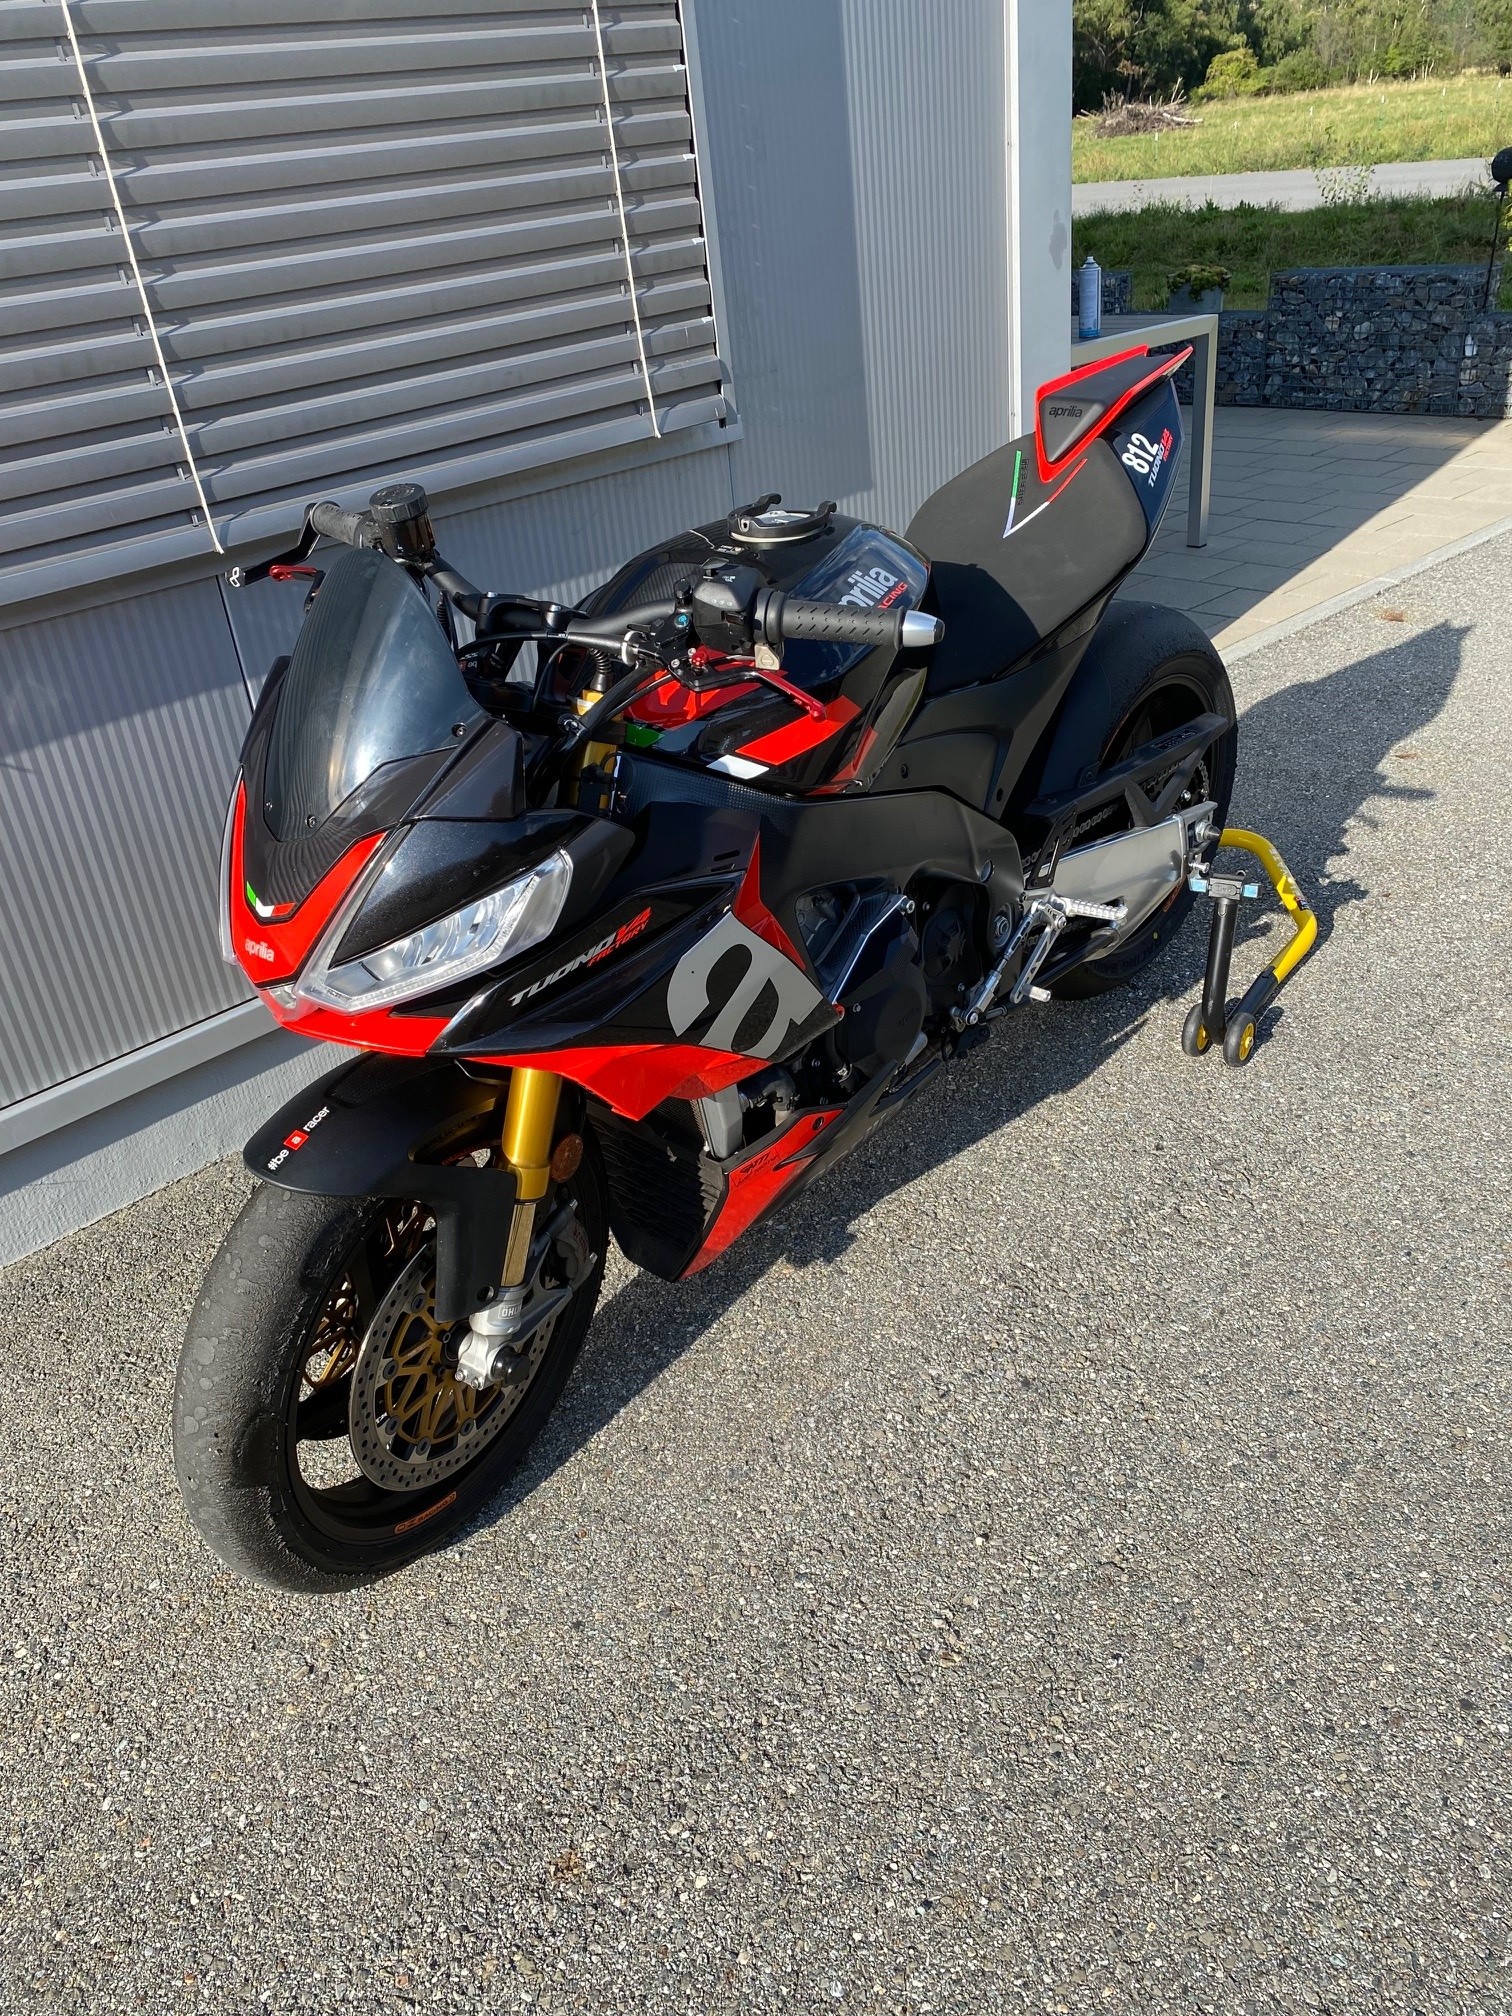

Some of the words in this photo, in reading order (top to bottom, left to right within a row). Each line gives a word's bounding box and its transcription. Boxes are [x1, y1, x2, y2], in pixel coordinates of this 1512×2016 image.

[1049, 406, 1083, 418] aprilia
[1121, 432, 1159, 474] 812
[1148, 443, 1165, 488] TUONO
[838, 567, 898, 607] prilia
[877, 581, 909, 608] CING
[245, 938, 274, 962] aprilia
[508, 932, 617, 1006] TUONO
[615, 907, 652, 942] V4
[587, 919, 650, 967] FACTORY
[267, 1149, 290, 1170] #be
[291, 1136, 302, 1145] a
[303, 1106, 330, 1132] racer
